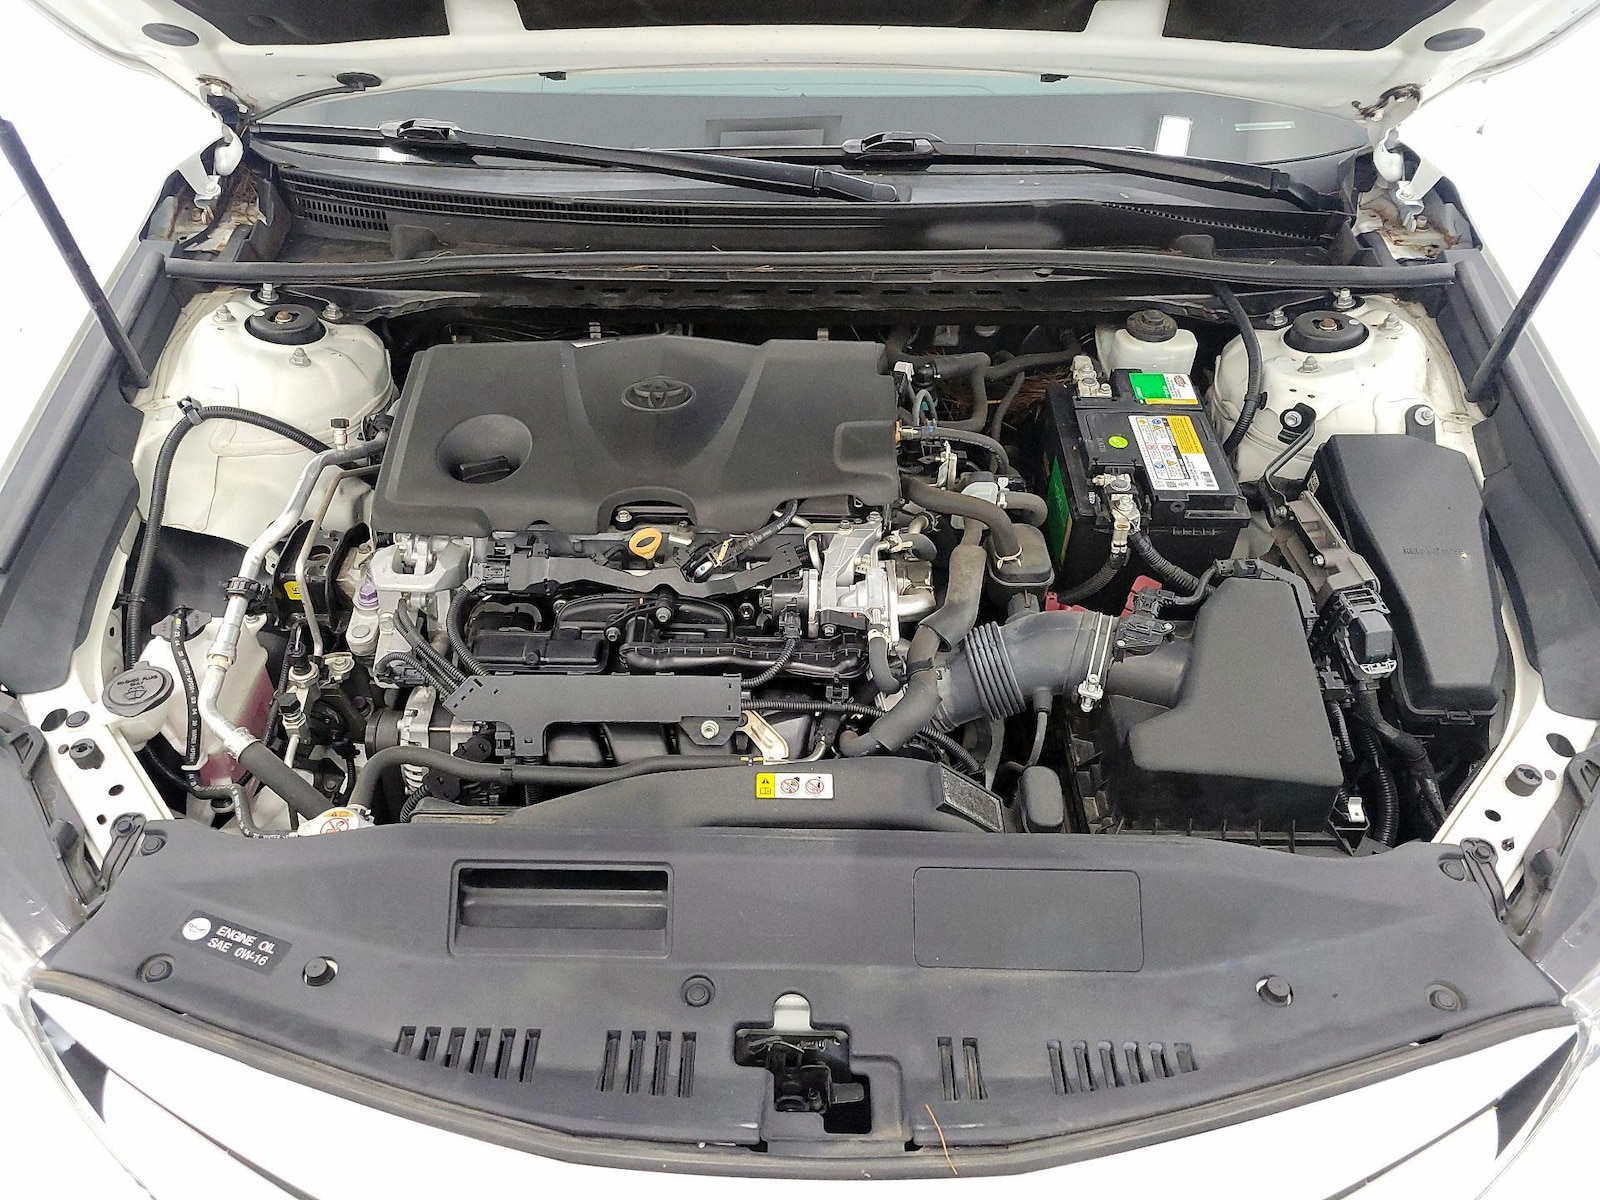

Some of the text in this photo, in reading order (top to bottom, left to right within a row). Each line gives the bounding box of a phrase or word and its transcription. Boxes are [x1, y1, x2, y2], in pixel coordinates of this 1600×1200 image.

[207, 937, 270, 966] SAE 0W-16
[216, 925, 276, 955] ENGINE OIL
